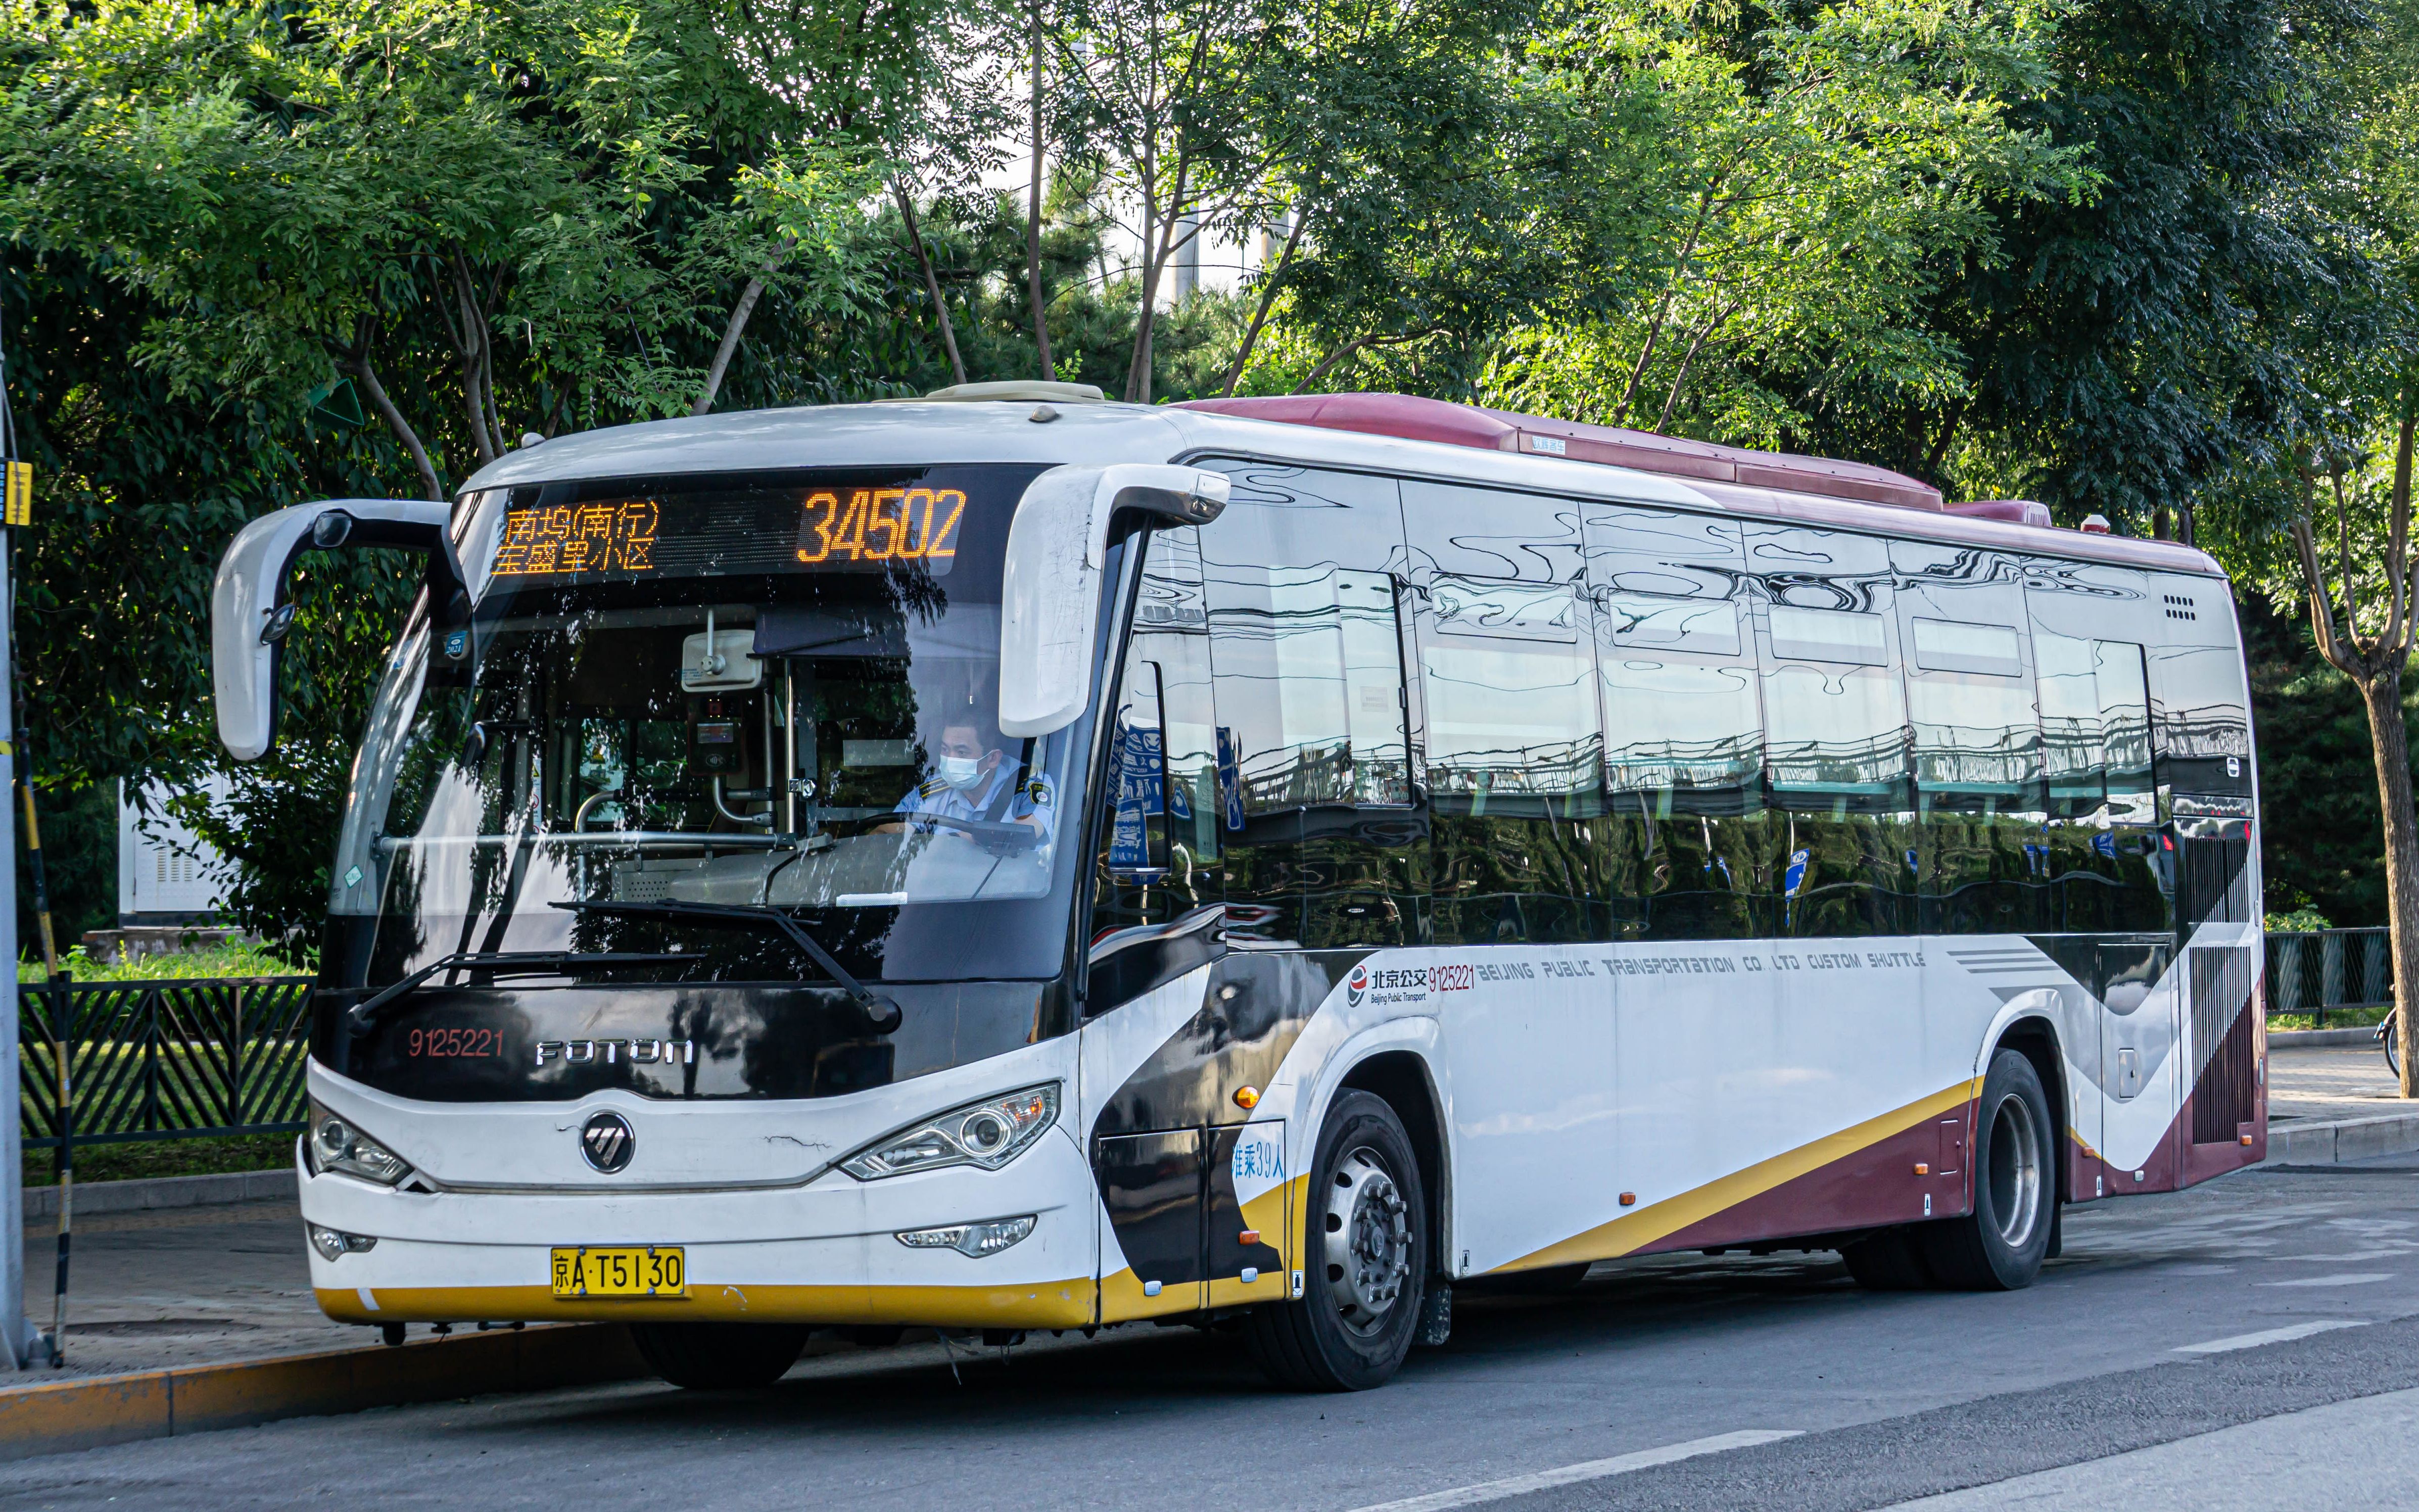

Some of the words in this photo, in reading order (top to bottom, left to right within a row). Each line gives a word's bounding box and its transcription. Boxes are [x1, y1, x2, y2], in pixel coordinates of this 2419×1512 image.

[797, 488, 966, 561] 34502
[1371, 969, 1428, 989] 北京公交
[1429, 964, 1475, 993] 9125221
[1476, 962, 1534, 981] BEIJING
[1542, 960, 1595, 977] PUBLIC
[1601, 957, 1736, 975] TRANSPORTATION
[1807, 953, 1862, 969] CUSTOM
[1867, 952, 1926, 967] SHUTTLE
[1371, 994, 1387, 1006] Beijing
[1388, 993, 1402, 1003] Public
[1403, 992, 1426, 1003] Transport
[409, 1028, 503, 1058] 9125221
[536, 1038, 693, 1065] FOTON
[1231, 1141, 1284, 1179] 准乘39人
